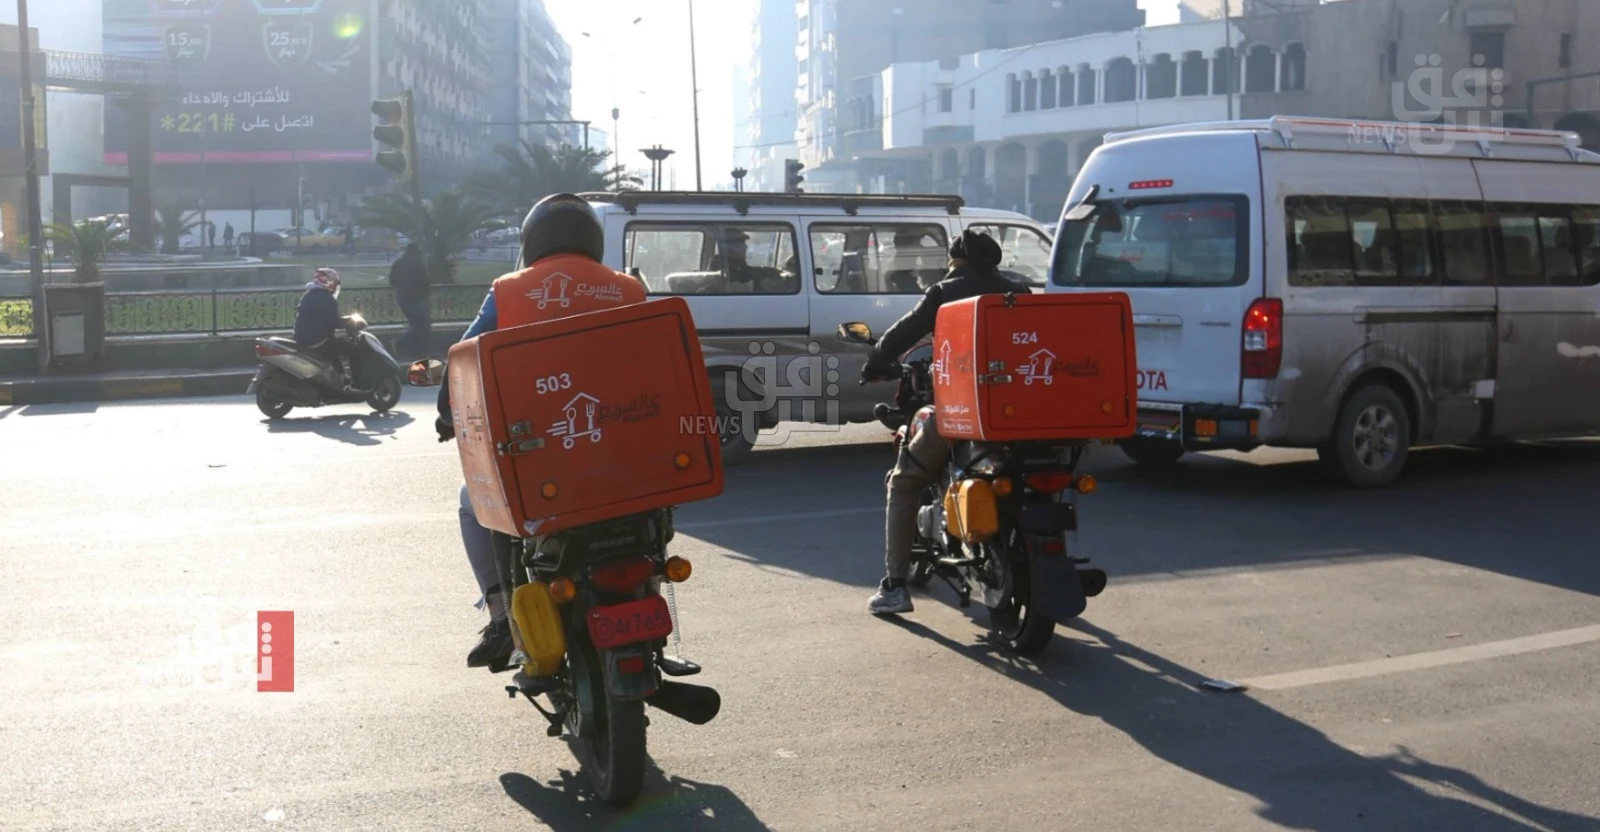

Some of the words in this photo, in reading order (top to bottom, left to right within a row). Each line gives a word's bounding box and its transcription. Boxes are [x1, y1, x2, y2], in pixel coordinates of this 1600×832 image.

[242, 115, 270, 132] على
[274, 115, 314, 132] اتصل
[1012, 332, 1038, 344] 524
[536, 373, 572, 394] 503
[1137, 370, 1168, 391] OTA
